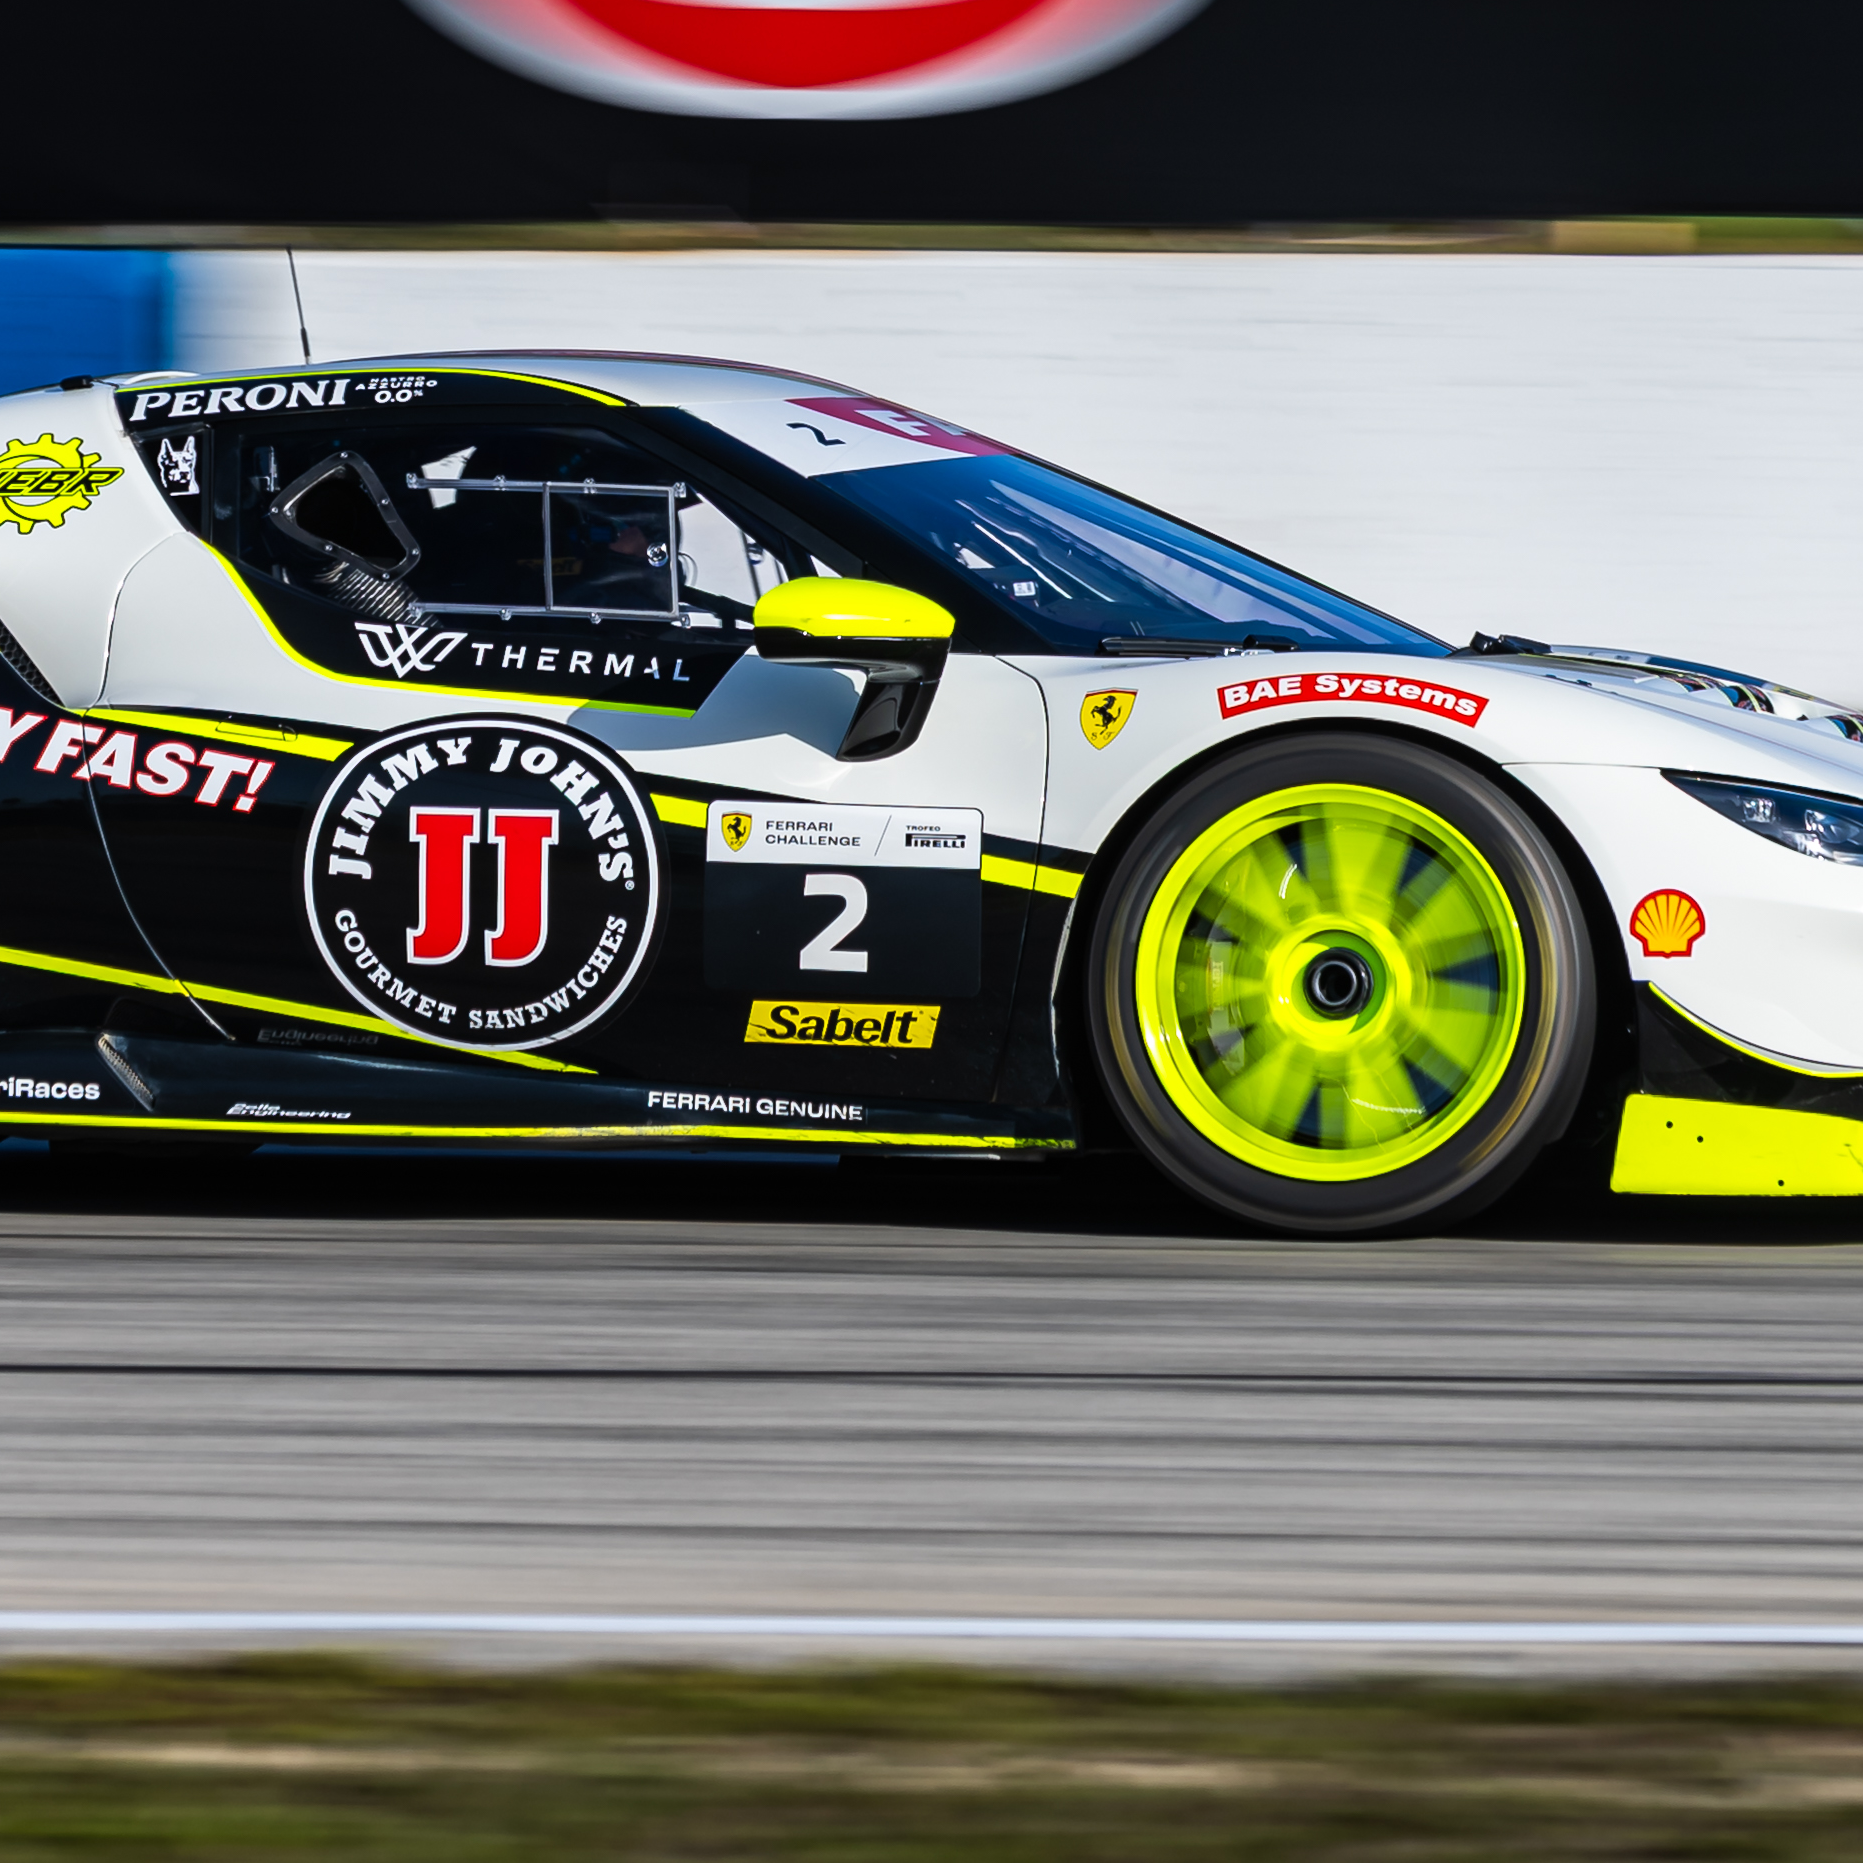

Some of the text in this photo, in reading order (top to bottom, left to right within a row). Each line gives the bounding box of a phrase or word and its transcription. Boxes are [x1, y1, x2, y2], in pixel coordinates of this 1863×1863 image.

[129, 378, 351, 422] PERONI
[355, 380, 438, 391] AZZURRO
[470, 642, 691, 682] THERMAL
[1223, 674, 1478, 717] BAE Systems
[35, 718, 276, 813] FAST!
[328, 736, 634, 882] JIMMY JOHN'S
[765, 820, 834, 832] FERRARI
[765, 834, 861, 846] CHALLENGE
[904, 833, 967, 848] PIRELLI
[405, 805, 560, 968] JJ
[799, 872, 869, 973] 2
[334, 909, 628, 1030] GOURMET SANDWICHES
[765, 1005, 918, 1044] Sabelt
[647, 1090, 864, 1121] FERRARI GENUINE
